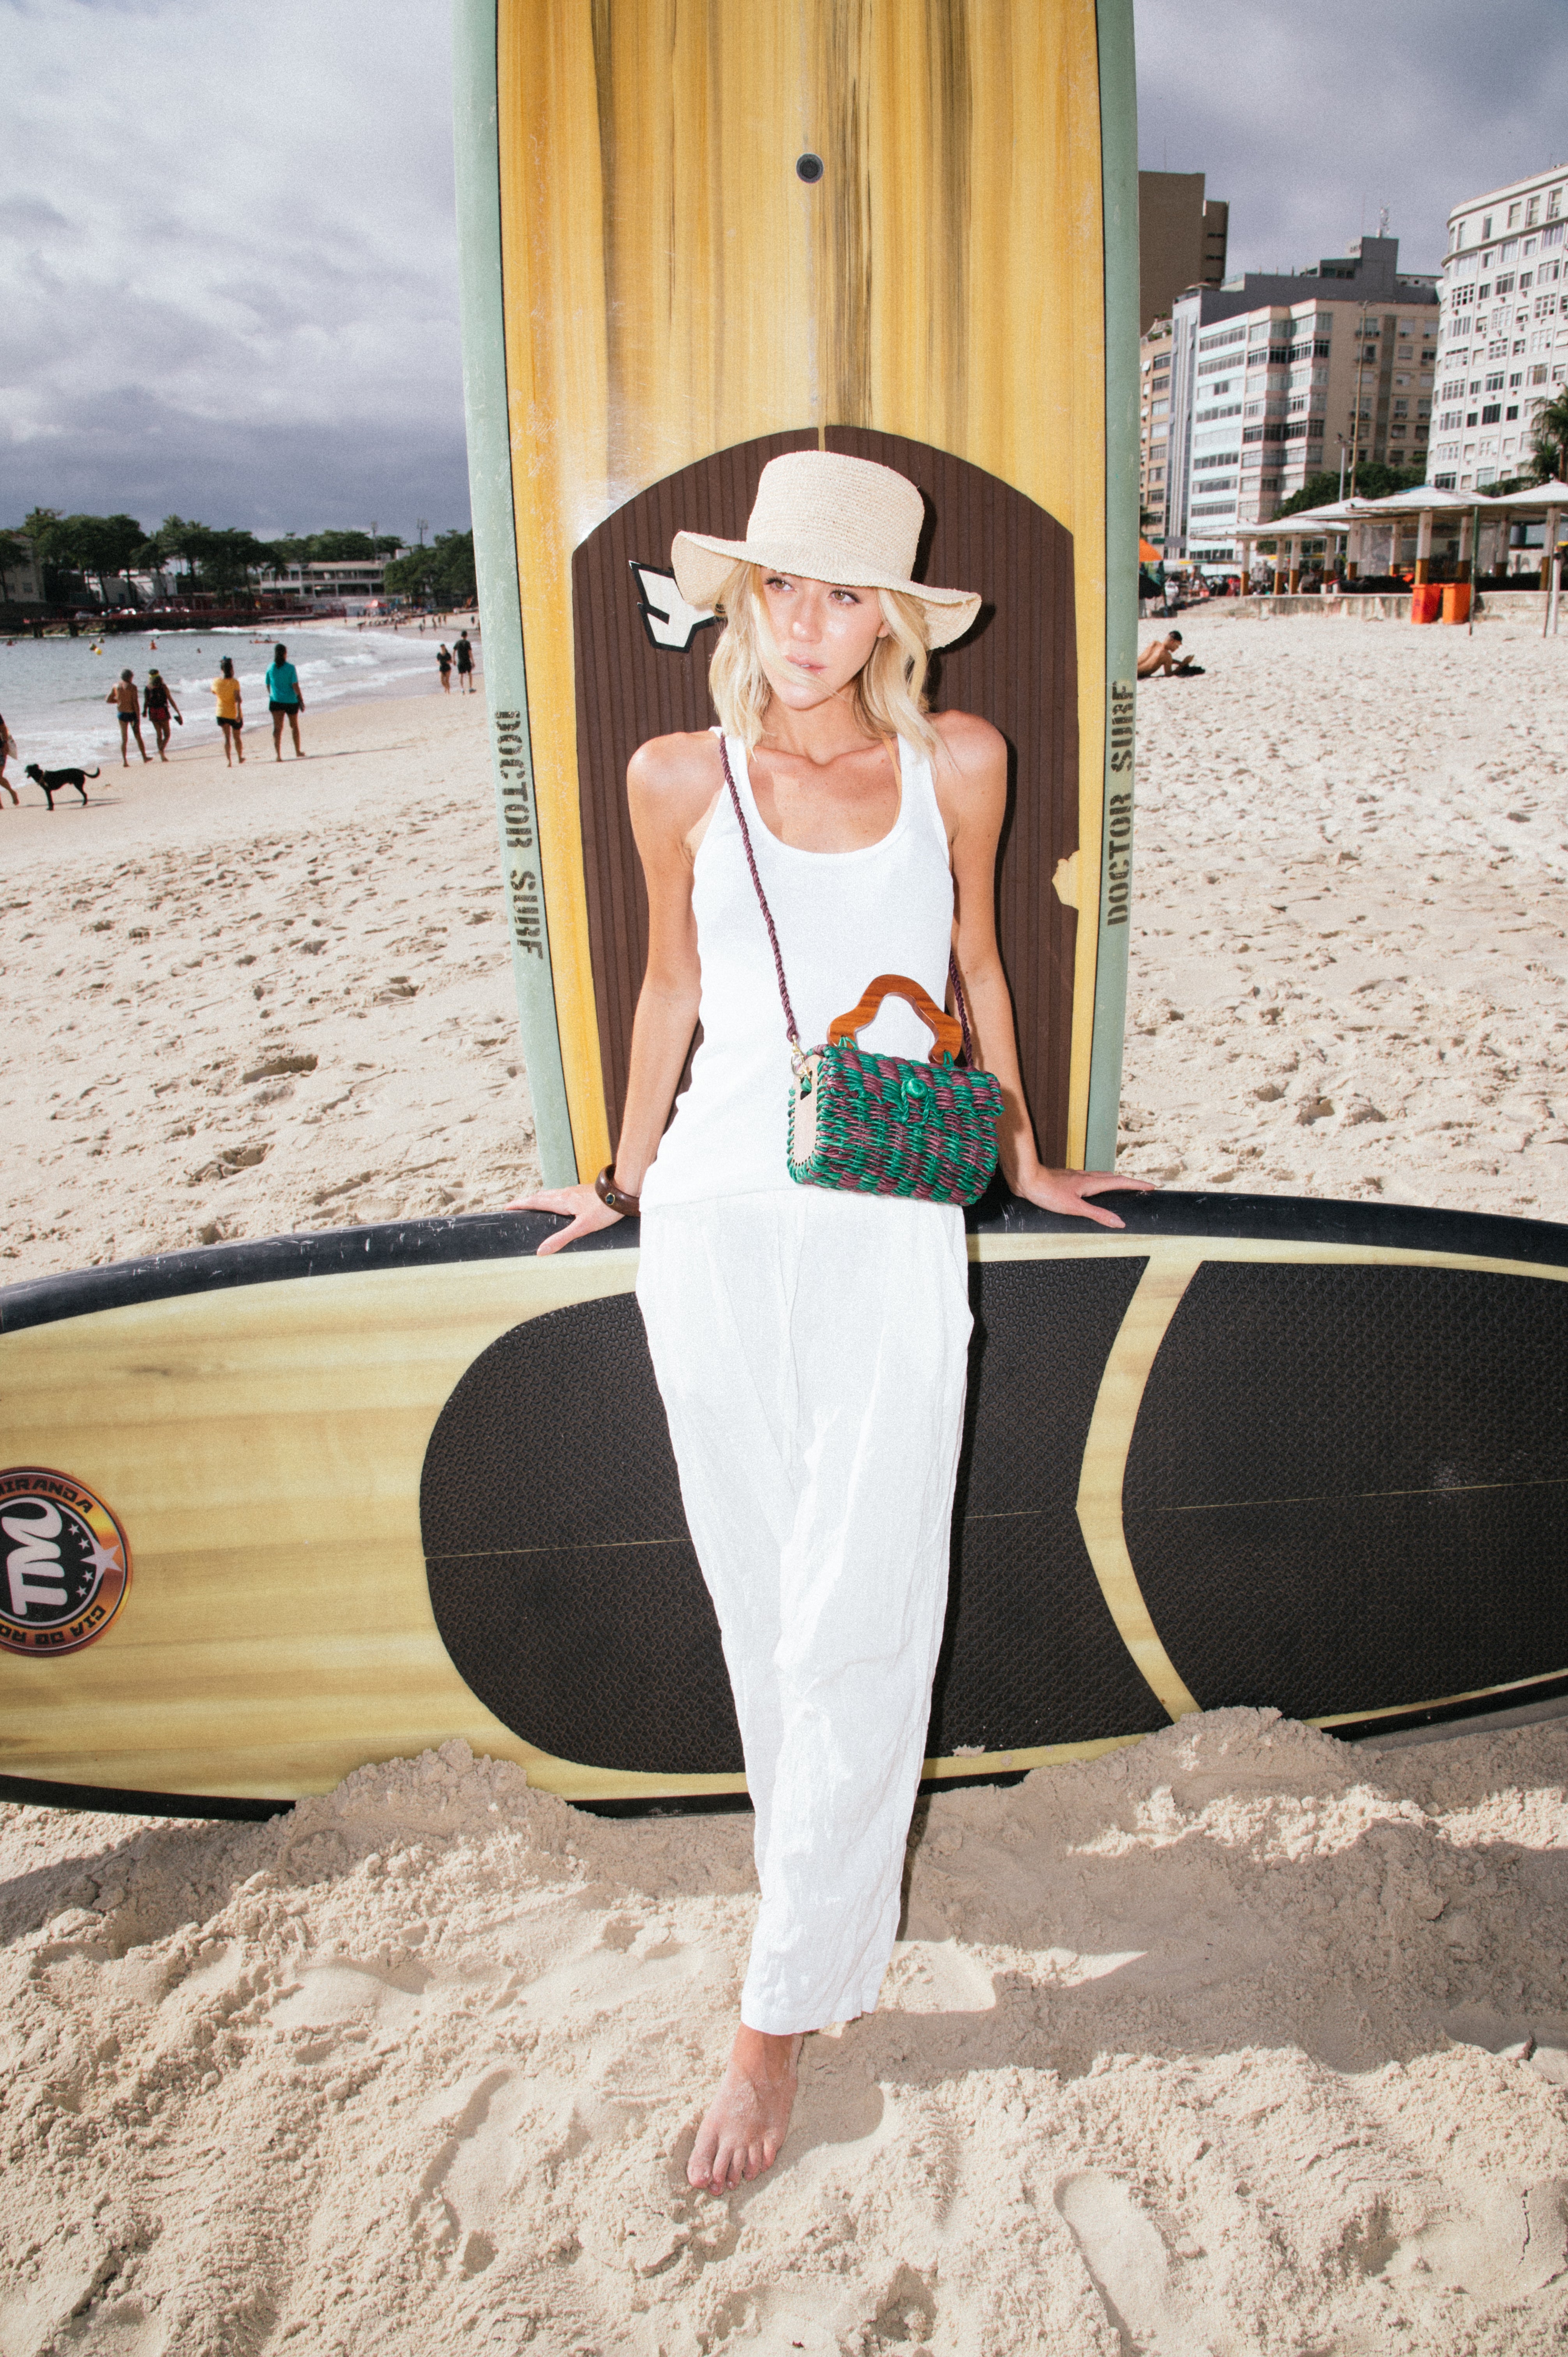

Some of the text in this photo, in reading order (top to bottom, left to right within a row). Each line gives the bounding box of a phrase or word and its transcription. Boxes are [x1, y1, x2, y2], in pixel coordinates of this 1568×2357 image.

[495, 711, 544, 960] DOCTOR SURF
[1107, 680, 1134, 926] DOCTOR SURF
[69, 1605, 106, 1637] CIA
